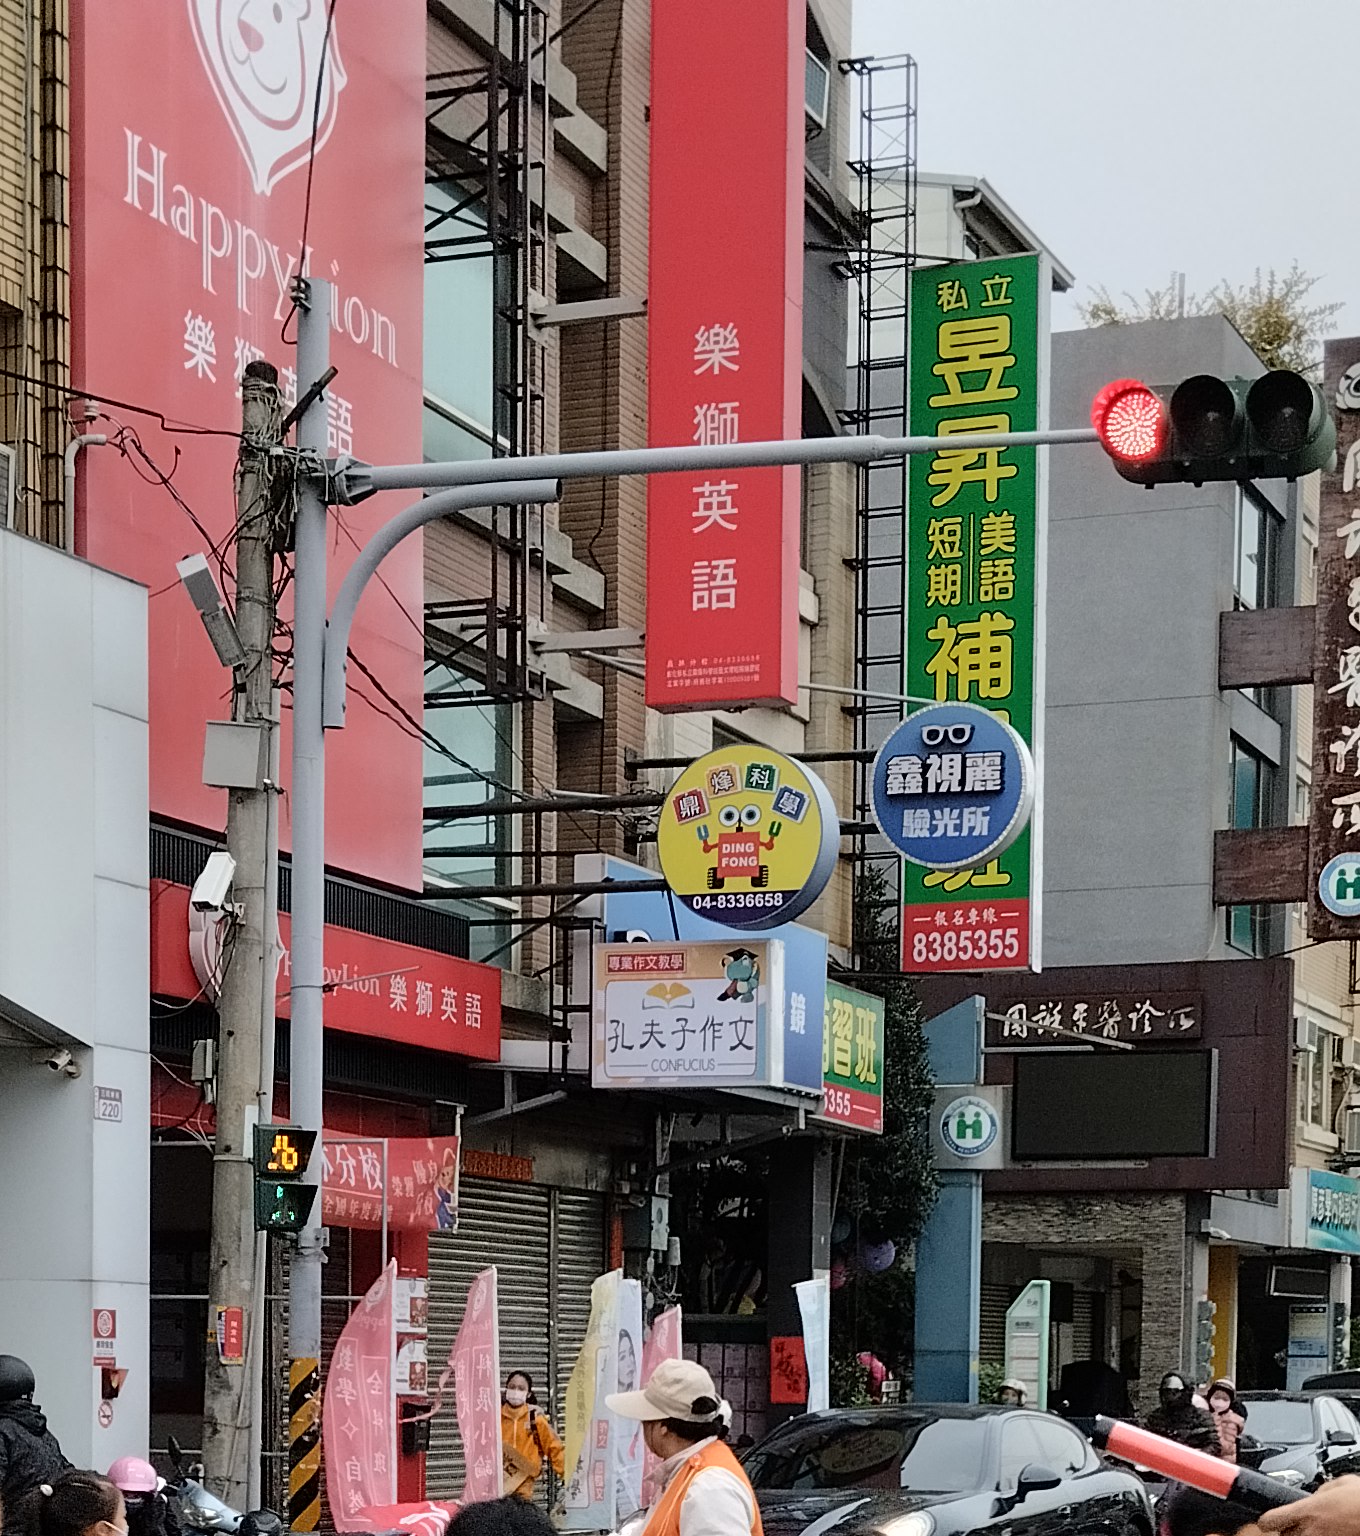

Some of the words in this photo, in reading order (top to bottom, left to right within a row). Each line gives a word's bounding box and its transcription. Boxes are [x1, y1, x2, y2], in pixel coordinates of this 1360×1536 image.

[937, 274, 1013, 312] 私立
[691, 322, 741, 612] 樂獅英語
[926, 515, 964, 608] 短期
[979, 509, 1017, 603] 美語
[886, 750, 1003, 796] 鑫視麗
[678, 767, 799, 818] 鼎烽科學
[902, 805, 991, 838] 驗光所
[721, 856, 758, 868] FONG
[722, 842, 755, 854] DING
[692, 892, 784, 910] 04-8336658
[934, 907, 999, 927] 報名專線
[609, 953, 684, 971] 專業作文教學
[912, 927, 1019, 964] 8385355
[389, 973, 482, 1029] 樂獅英語
[607, 1014, 755, 1053] 孔夫子作文
[650, 1057, 716, 1073] CONFUCIUS
[101, 1101, 120, 1118] 220
